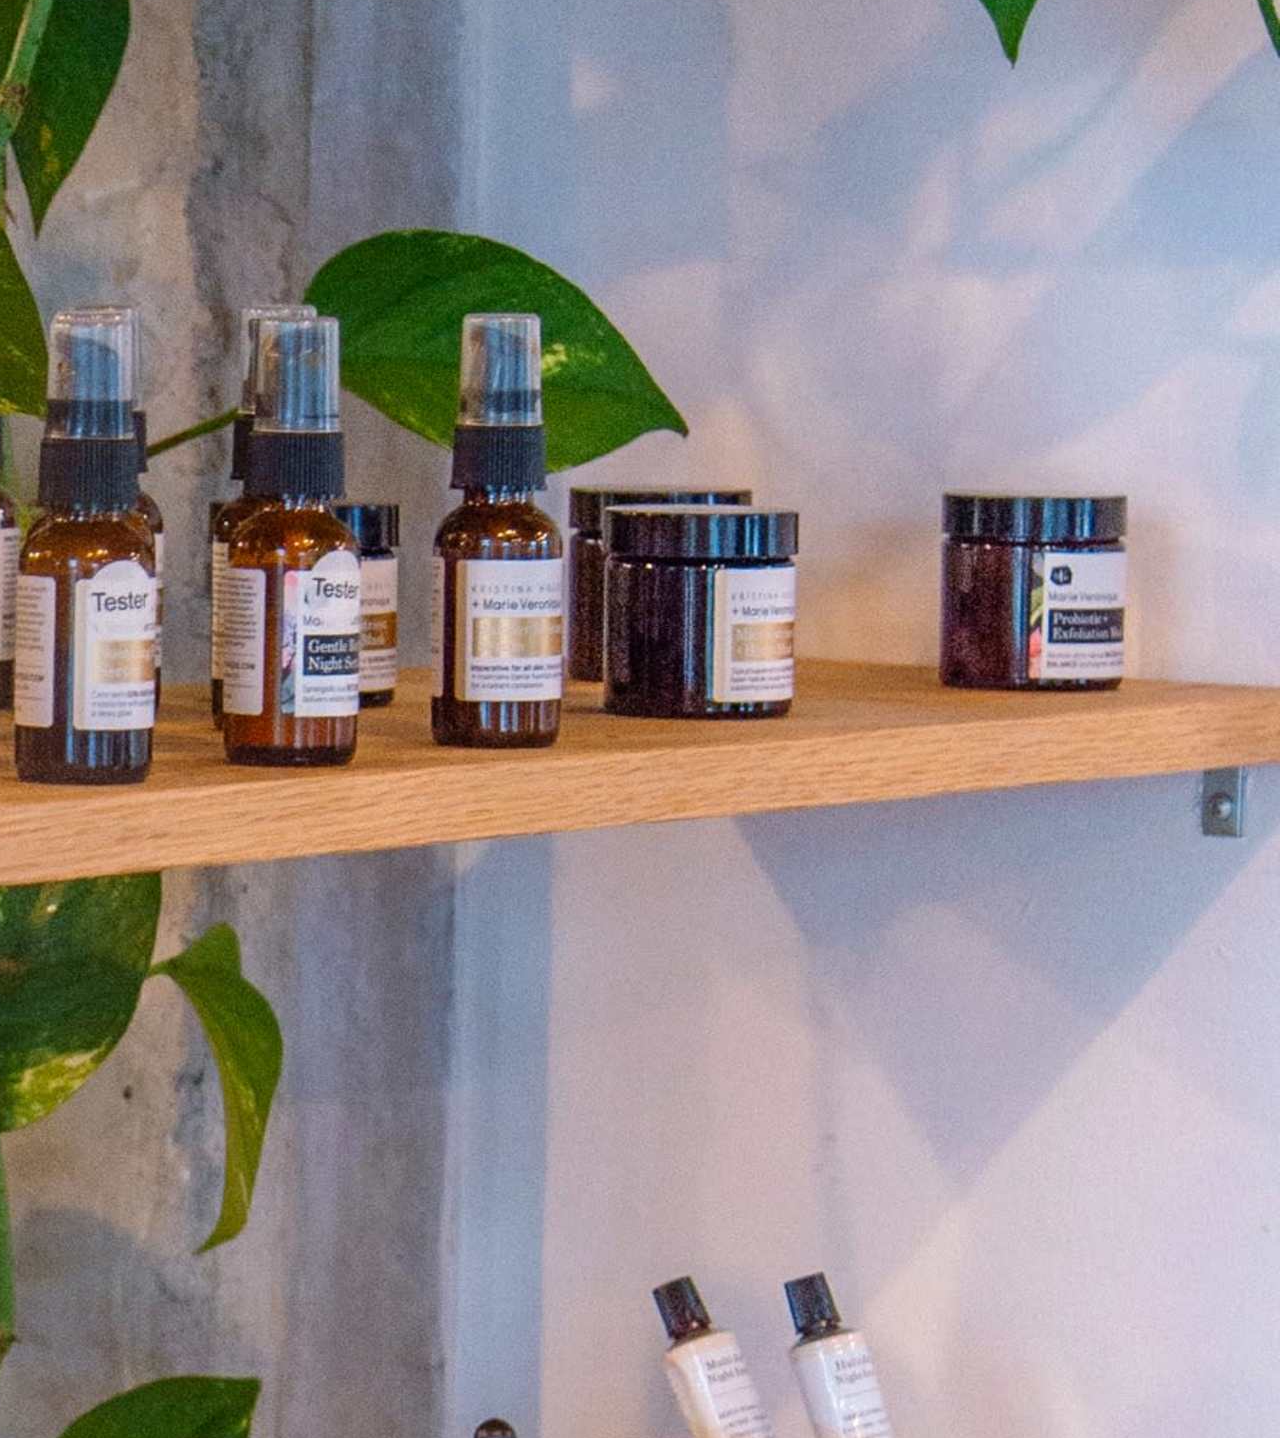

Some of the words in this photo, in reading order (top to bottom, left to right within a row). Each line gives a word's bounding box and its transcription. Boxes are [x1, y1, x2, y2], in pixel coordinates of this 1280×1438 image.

[313, 577, 358, 599] Tester
[91, 592, 149, 612] Tester
[483, 598, 519, 611] Marie
[308, 639, 348, 653] Gentle
[308, 656, 343, 673] Night
